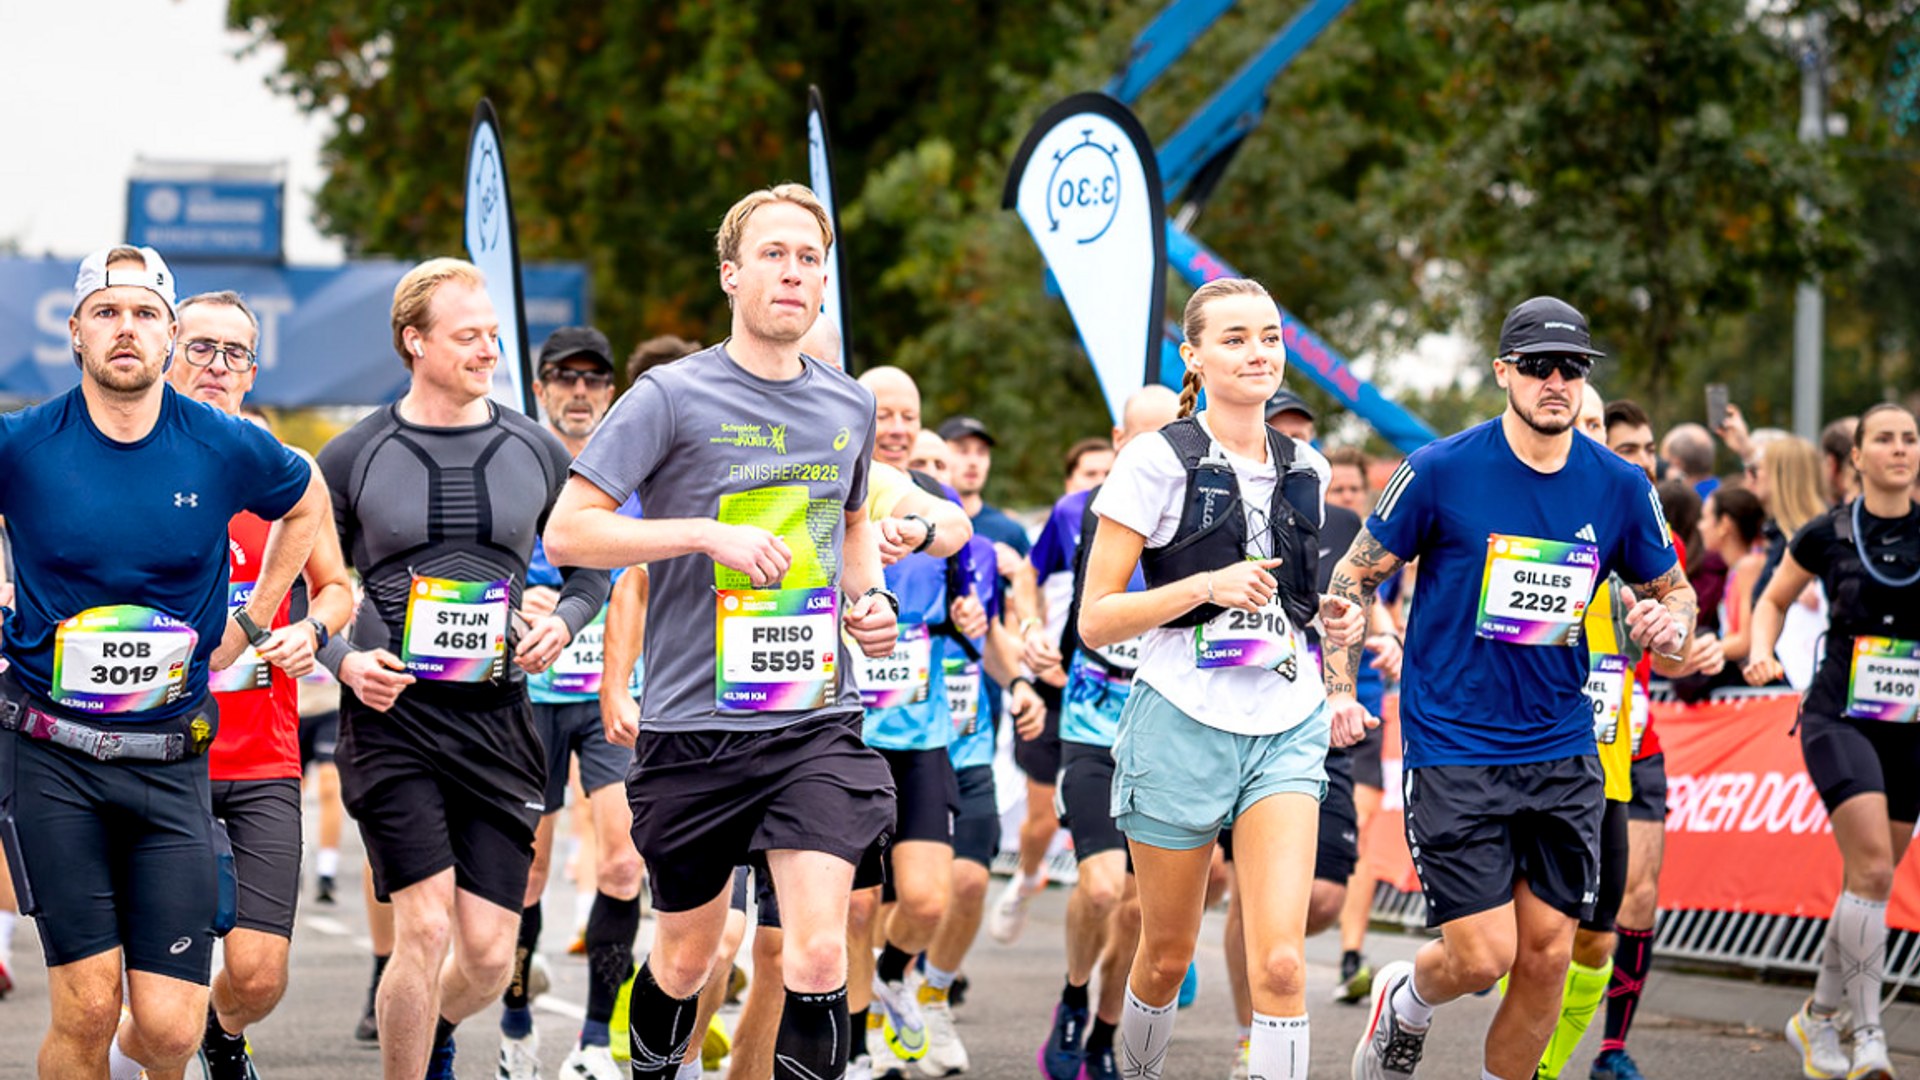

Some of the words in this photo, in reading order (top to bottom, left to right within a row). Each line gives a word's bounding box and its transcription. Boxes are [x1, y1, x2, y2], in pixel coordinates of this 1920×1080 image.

[1513, 569, 1573, 589] GILLES
[1508, 590, 1568, 614] 2292
[436, 610, 490, 626] STIJN
[1228, 610, 1286, 637] 2910
[433, 630, 488, 650] 4681
[752, 625, 814, 644] FRISO
[102, 642, 151, 658] ROB
[750, 649, 816, 673] 5595
[90, 665, 159, 686] 3019
[865, 667, 910, 681] 1462
[1874, 681, 1915, 697] 1490
